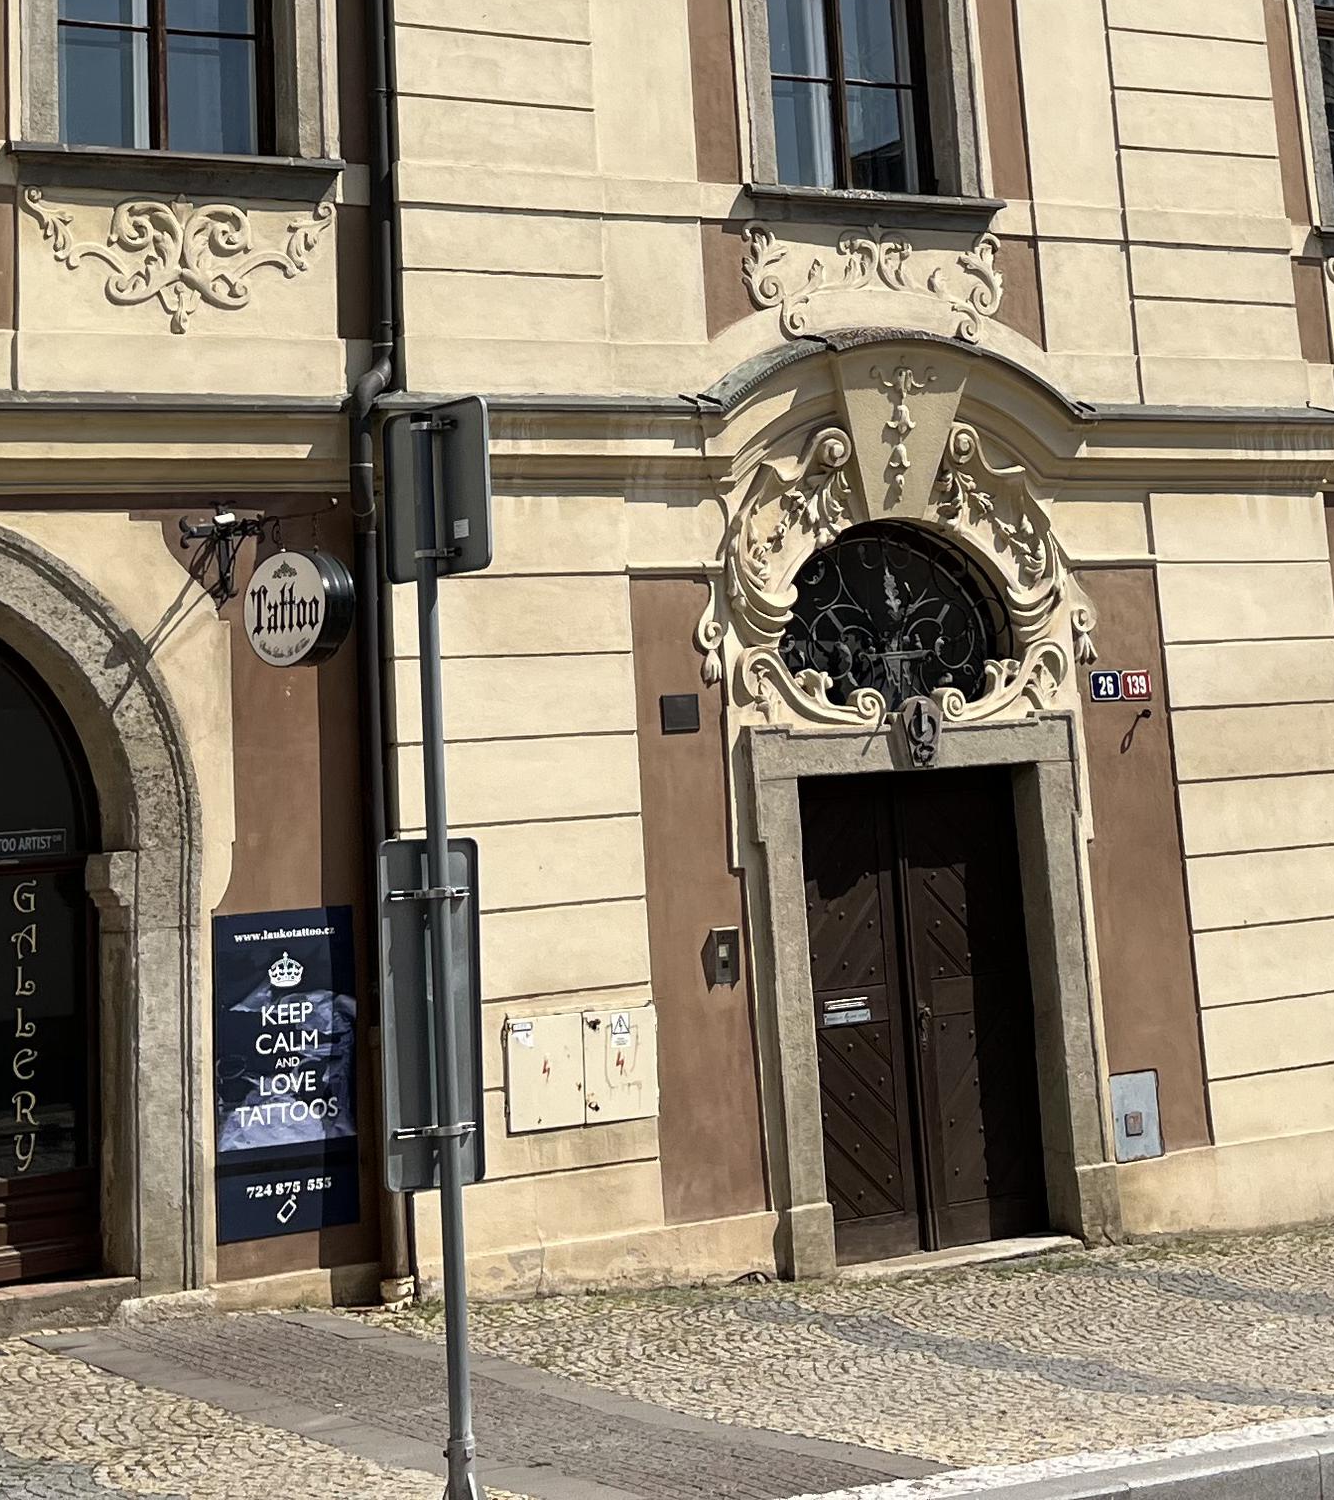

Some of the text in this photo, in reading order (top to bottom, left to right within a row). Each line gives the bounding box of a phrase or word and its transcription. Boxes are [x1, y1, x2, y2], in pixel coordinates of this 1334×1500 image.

[250, 582, 320, 640] Tattoo
[1098, 675, 1147, 696] 26 139
[17, 835, 52, 851] ARTIST
[233, 927, 335, 943] www.laukotattoo.cz
[11, 879, 38, 1172] GALLERY
[261, 1001, 314, 1027] KEEP
[255, 1029, 319, 1055] CALM
[275, 1056, 300, 1069] AND
[259, 1071, 316, 1096] LOVE
[235, 1096, 339, 1128] TATTOOS
[246, 1176, 332, 1199] 724 875 555
